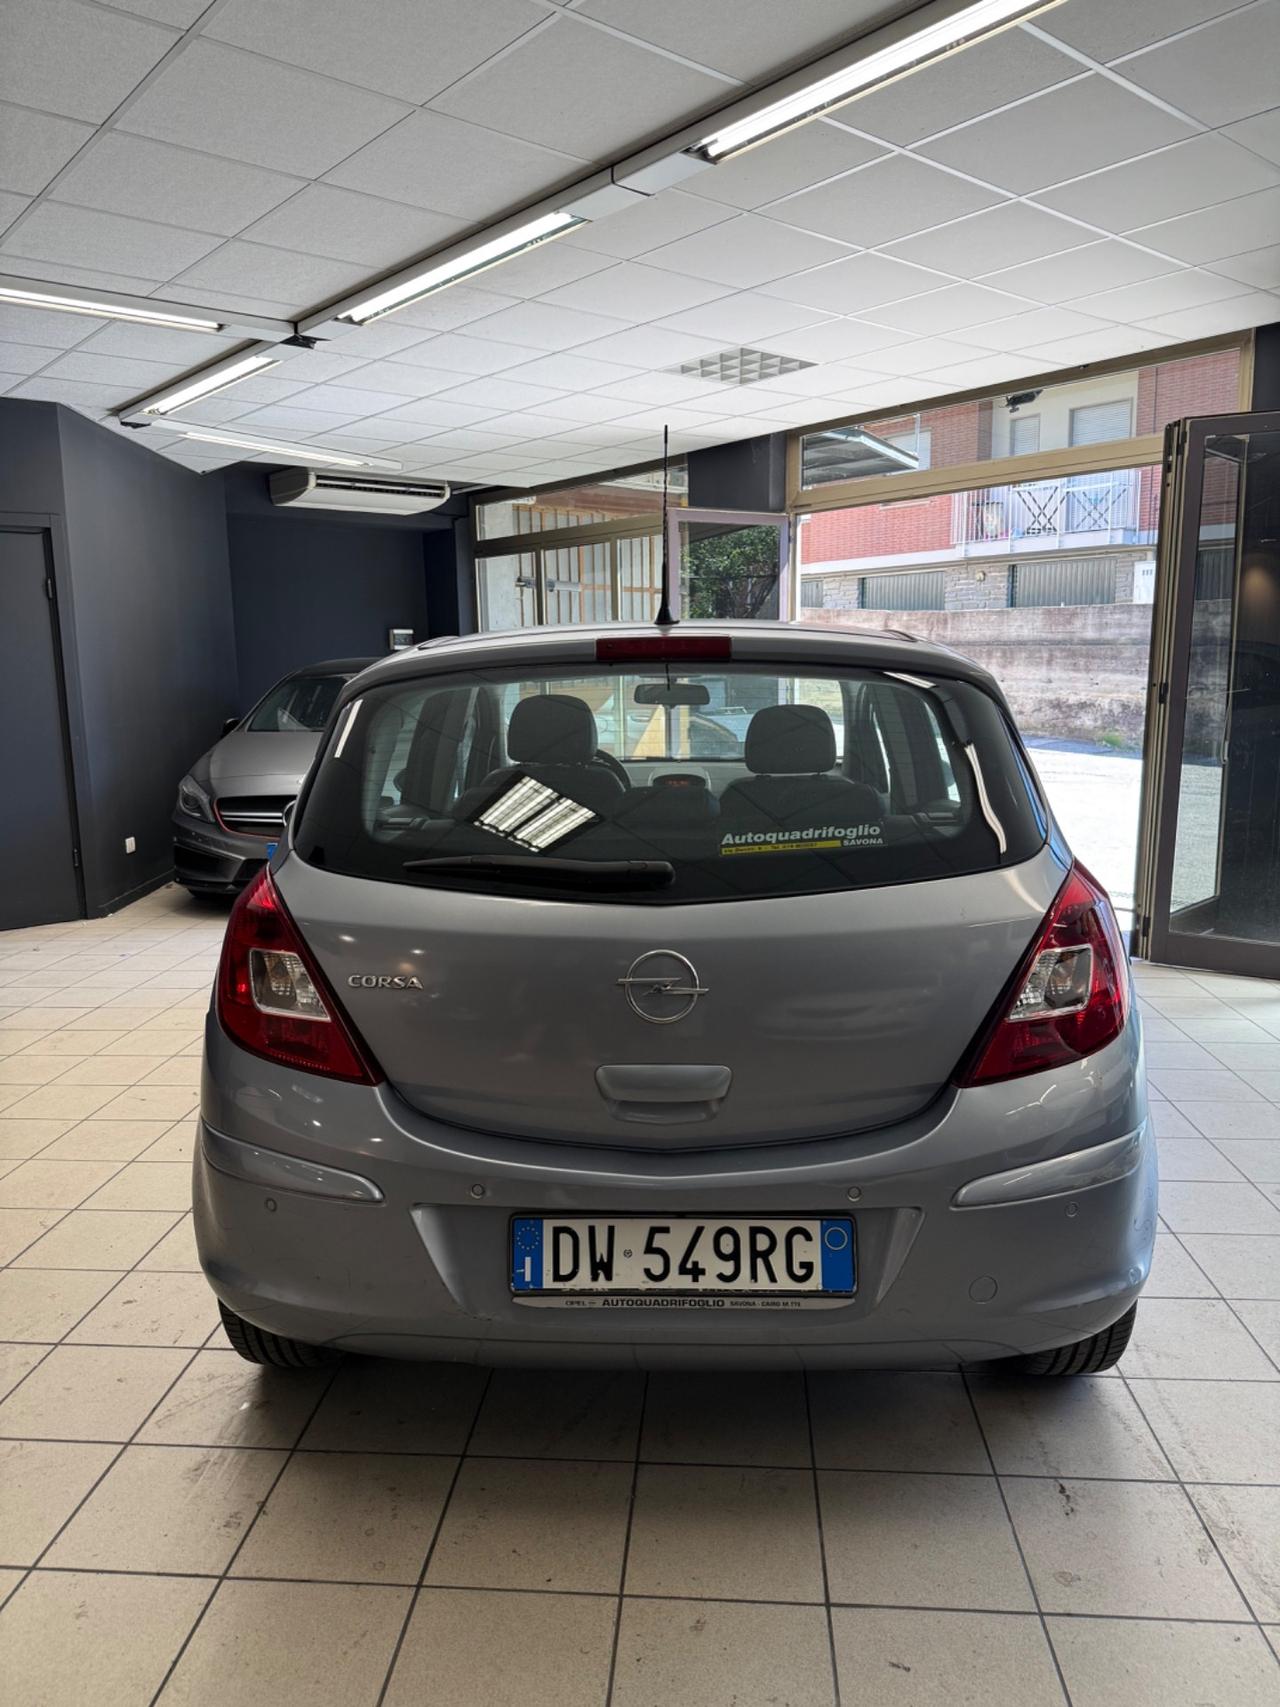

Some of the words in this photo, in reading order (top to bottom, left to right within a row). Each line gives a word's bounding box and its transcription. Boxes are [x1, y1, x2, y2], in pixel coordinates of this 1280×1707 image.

[721, 823, 881, 845] Autoquadrifoglio
[843, 837, 884, 847] SAVONA
[347, 974, 424, 990] CORSA
[552, 1224, 615, 1283] DW
[642, 1225, 814, 1284] 549RG
[525, 1256, 532, 1282] I
[602, 1299, 725, 1307] AUTOQUADRIFOGLIO
